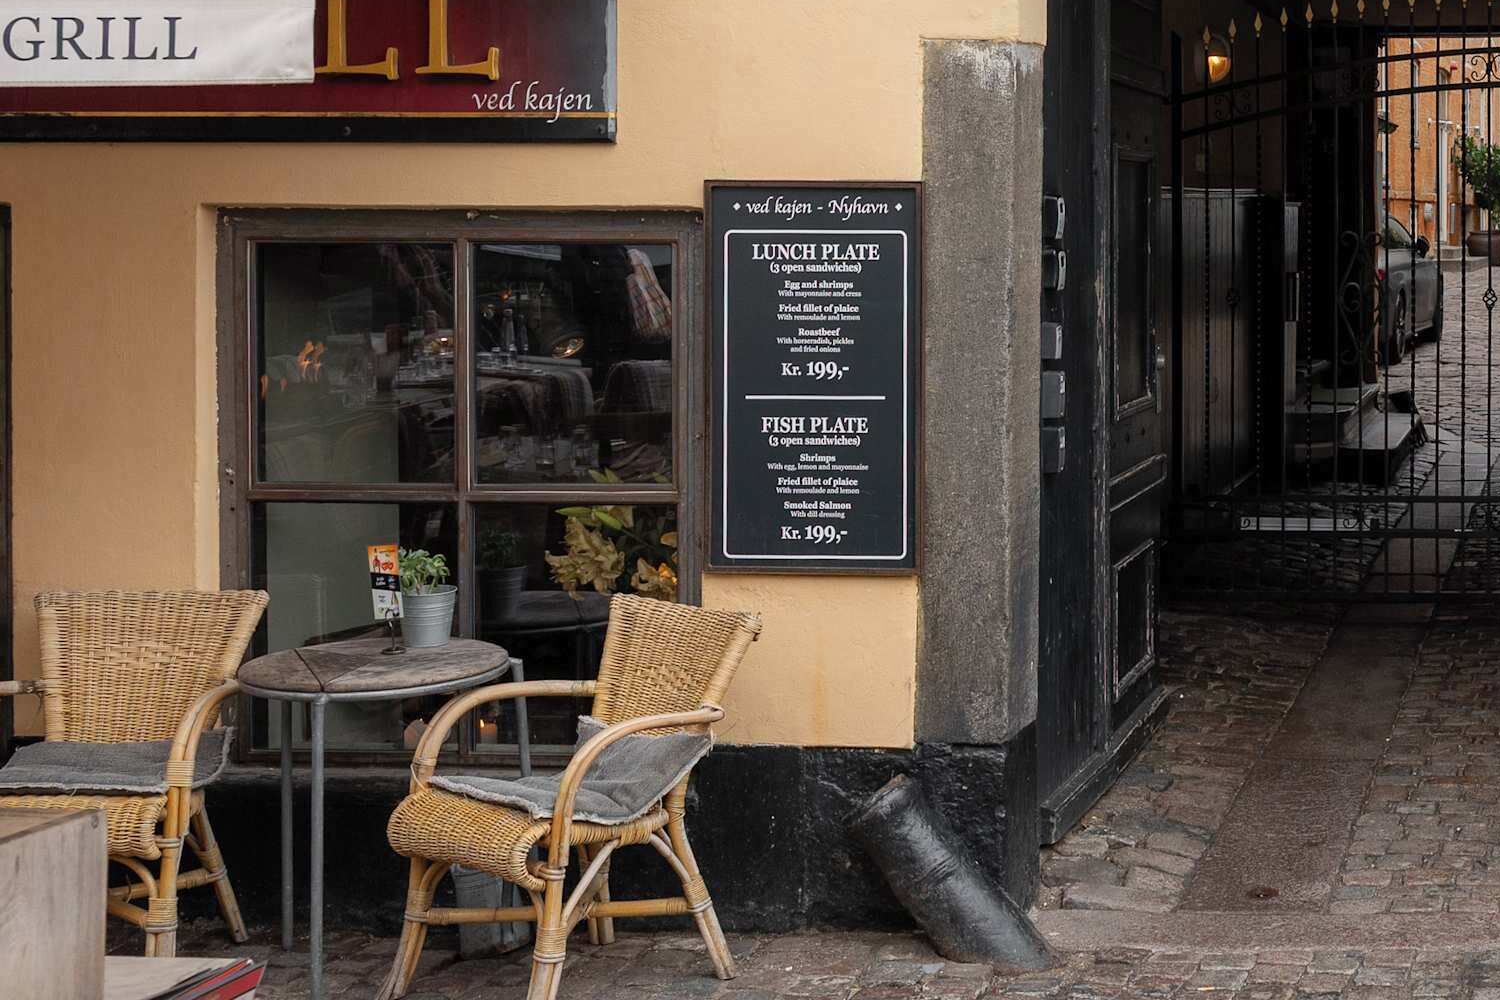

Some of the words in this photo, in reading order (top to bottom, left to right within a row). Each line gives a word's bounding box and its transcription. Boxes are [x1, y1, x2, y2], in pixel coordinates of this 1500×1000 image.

[3, 15, 198, 63] GRILL
[472, 81, 516, 111] ved
[524, 81, 593, 123] kajen
[745, 196, 773, 214] ved
[774, 196, 812, 221] kajen
[828, 196, 889, 221] Nyhavn
[751, 243, 817, 261] LUNCH
[820, 243, 880, 261] PLATE
[769, 262, 780, 274] (3
[781, 263, 805, 274] open
[805, 262, 862, 274] sandwiches)
[784, 280, 800, 290] Egg
[801, 280, 818, 289] and
[818, 280, 854, 291] shrimps
[777, 289, 794, 297] With
[778, 304, 802, 313] Fried
[802, 304, 823, 313] fillet
[823, 304, 834, 313] of
[833, 304, 860, 314] plaice
[776, 313, 793, 321] With
[827, 313, 840, 321] and
[798, 327, 841, 337] Roastbeef
[776, 336, 793, 345] With
[790, 345, 803, 353] and
[803, 345, 819, 353] fried
[819, 345, 841, 353] onions
[781, 362, 802, 376] Kr.
[806, 361, 850, 380] 199,-
[760, 416, 806, 434] FISH
[809, 416, 869, 434] PLATE
[768, 435, 780, 447] (3
[780, 436, 804, 447] open
[804, 435, 861, 447] sandwiches)
[799, 453, 837, 464] Shrimps
[767, 462, 784, 471] With
[818, 463, 831, 471] and
[777, 477, 801, 486] Fried
[801, 477, 822, 486] fillet
[822, 477, 833, 486] of
[832, 477, 859, 487] plaice
[775, 486, 792, 494] With
[826, 486, 839, 495] and
[783, 501, 818, 510] Smoked
[818, 501, 852, 510] Salmon
[790, 510, 807, 518] With
[780, 526, 802, 540] Kr.
[804, 525, 848, 544] 199,-
